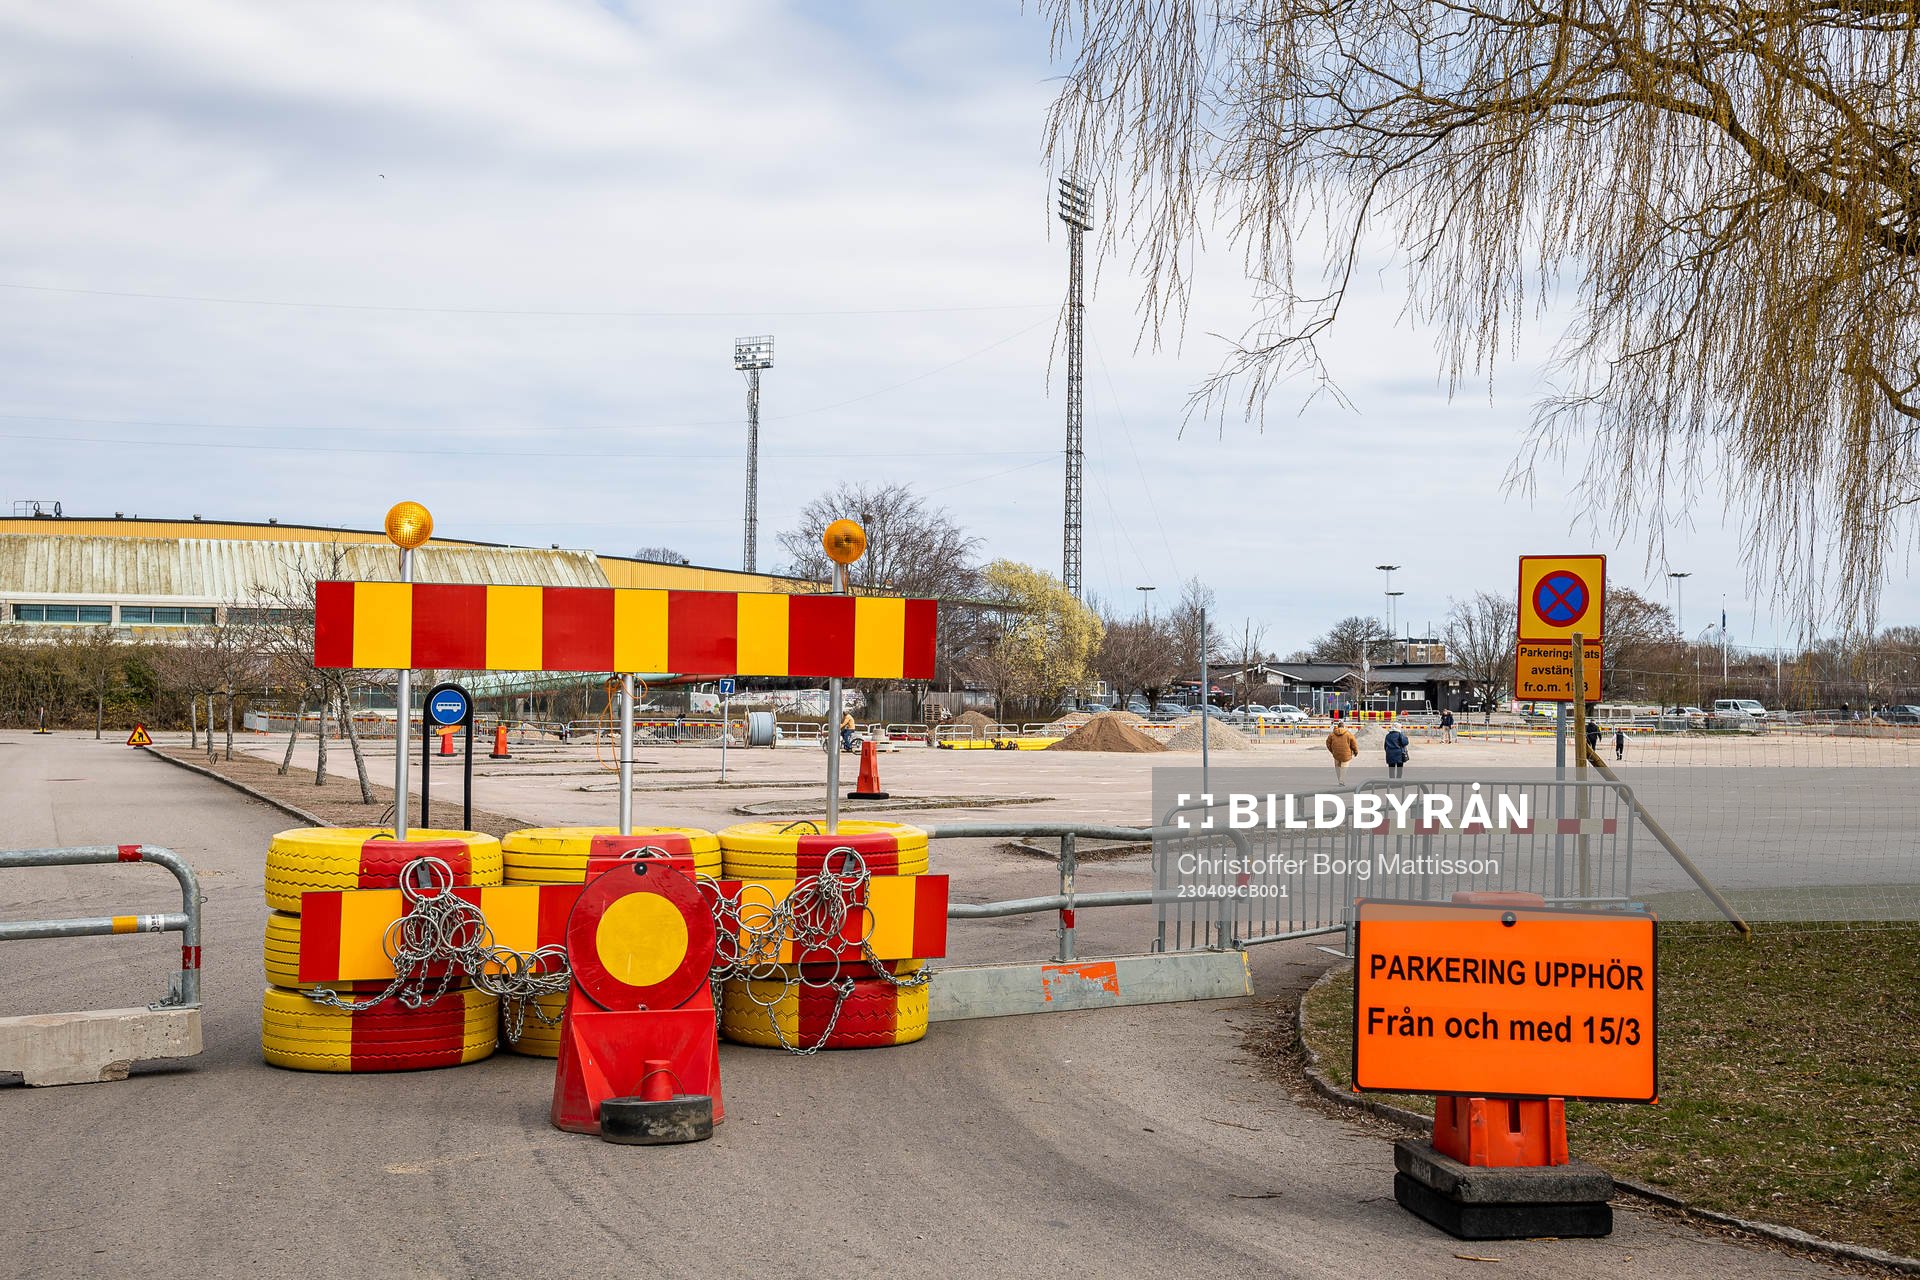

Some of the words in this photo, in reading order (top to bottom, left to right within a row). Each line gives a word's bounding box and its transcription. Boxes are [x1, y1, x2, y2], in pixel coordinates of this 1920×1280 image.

[1520, 647, 1600, 660] Parkeringsats
[723, 682, 731, 692] 7
[1524, 681, 1561, 692] fr.o.m.
[1565, 682, 1589, 692] 13
[1370, 954, 1526, 986] PARKERING
[1535, 958, 1645, 991] UPPHÖR
[1367, 1006, 1434, 1037] Från
[1445, 1011, 1499, 1040] och
[1509, 1015, 1572, 1042] med
[1583, 1016, 1641, 1046] 15/3
